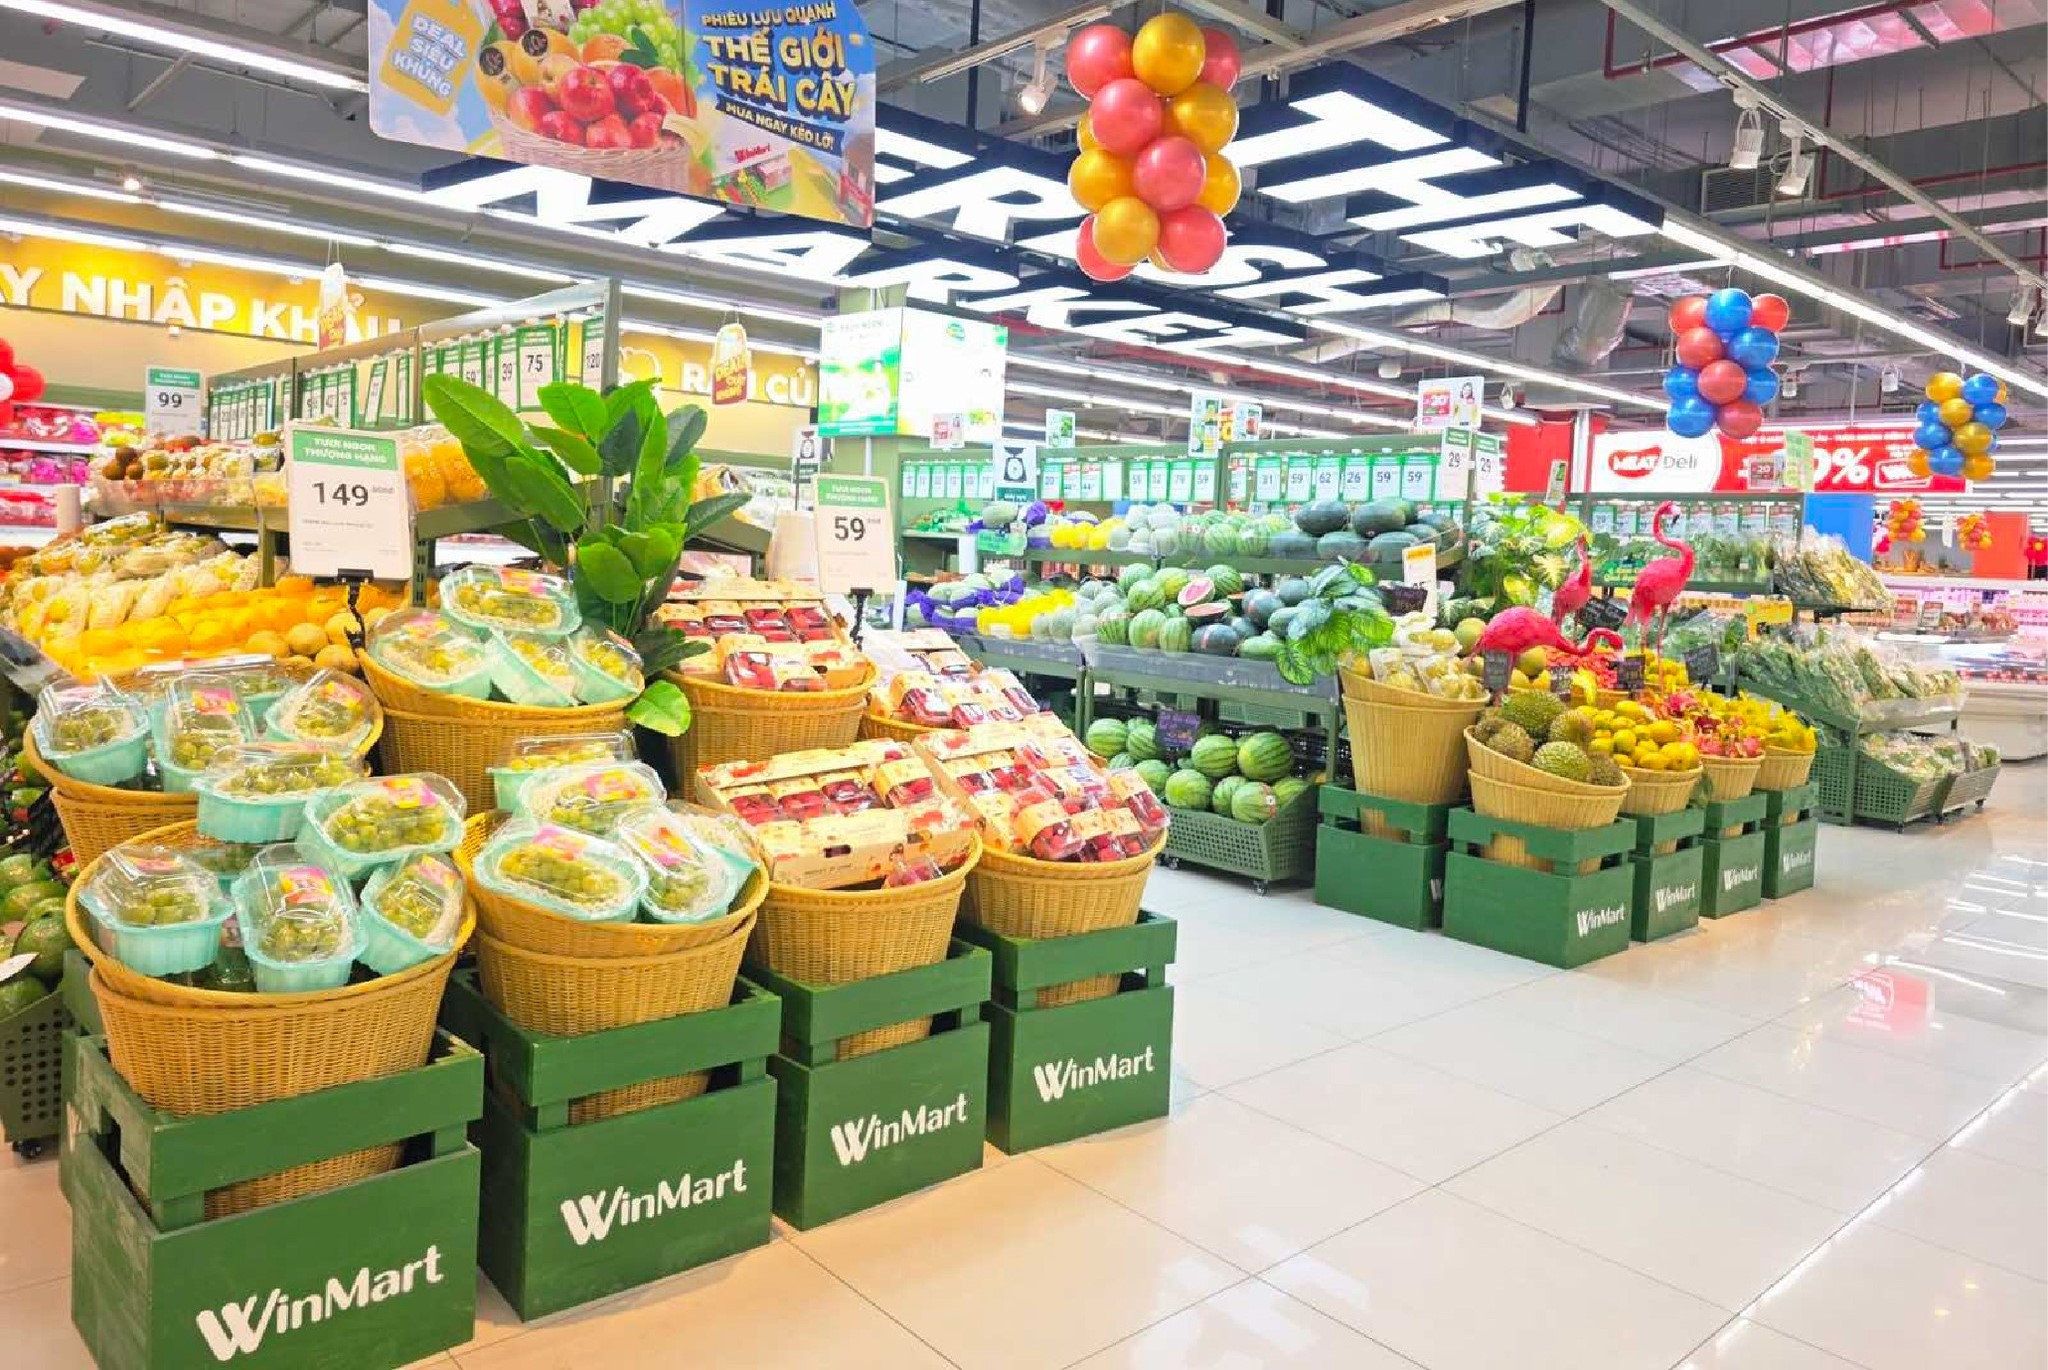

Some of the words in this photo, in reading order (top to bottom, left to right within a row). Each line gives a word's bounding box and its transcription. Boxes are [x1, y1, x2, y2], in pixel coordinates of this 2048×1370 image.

[702, 10, 748, 27] PHIÊU
[752, 8, 783, 26] LƯU
[785, 1, 836, 24] QUANH
[412, 14, 466, 58] DEAL
[702, 26, 772, 65] THẾ
[779, 26, 846, 71] GIỚI
[707, 61, 787, 109] TRÁI
[795, 70, 856, 120] CÂY
[725, 102, 754, 121] MUA
[756, 113, 788, 134] NGAY
[61, 275, 238, 336] NHẬP
[527, 354, 543, 372] 75
[158, 391, 182, 408] 99
[1449, 452, 1461, 468] 29
[1663, 453, 1698, 469] Deli
[1377, 471, 1391, 483] 59
[1408, 471, 1422, 483] 59
[312, 482, 369, 506] 149
[835, 515, 865, 541] 59
[1724, 863, 1759, 891] WinMart
[1655, 882, 1696, 913] WinMart
[1576, 903, 1625, 938] WinMart
[1033, 1045, 1155, 1102] WinMart
[830, 1092, 967, 1166] WinMart
[560, 1157, 748, 1247] WinMart
[196, 1244, 443, 1362] WinMart
